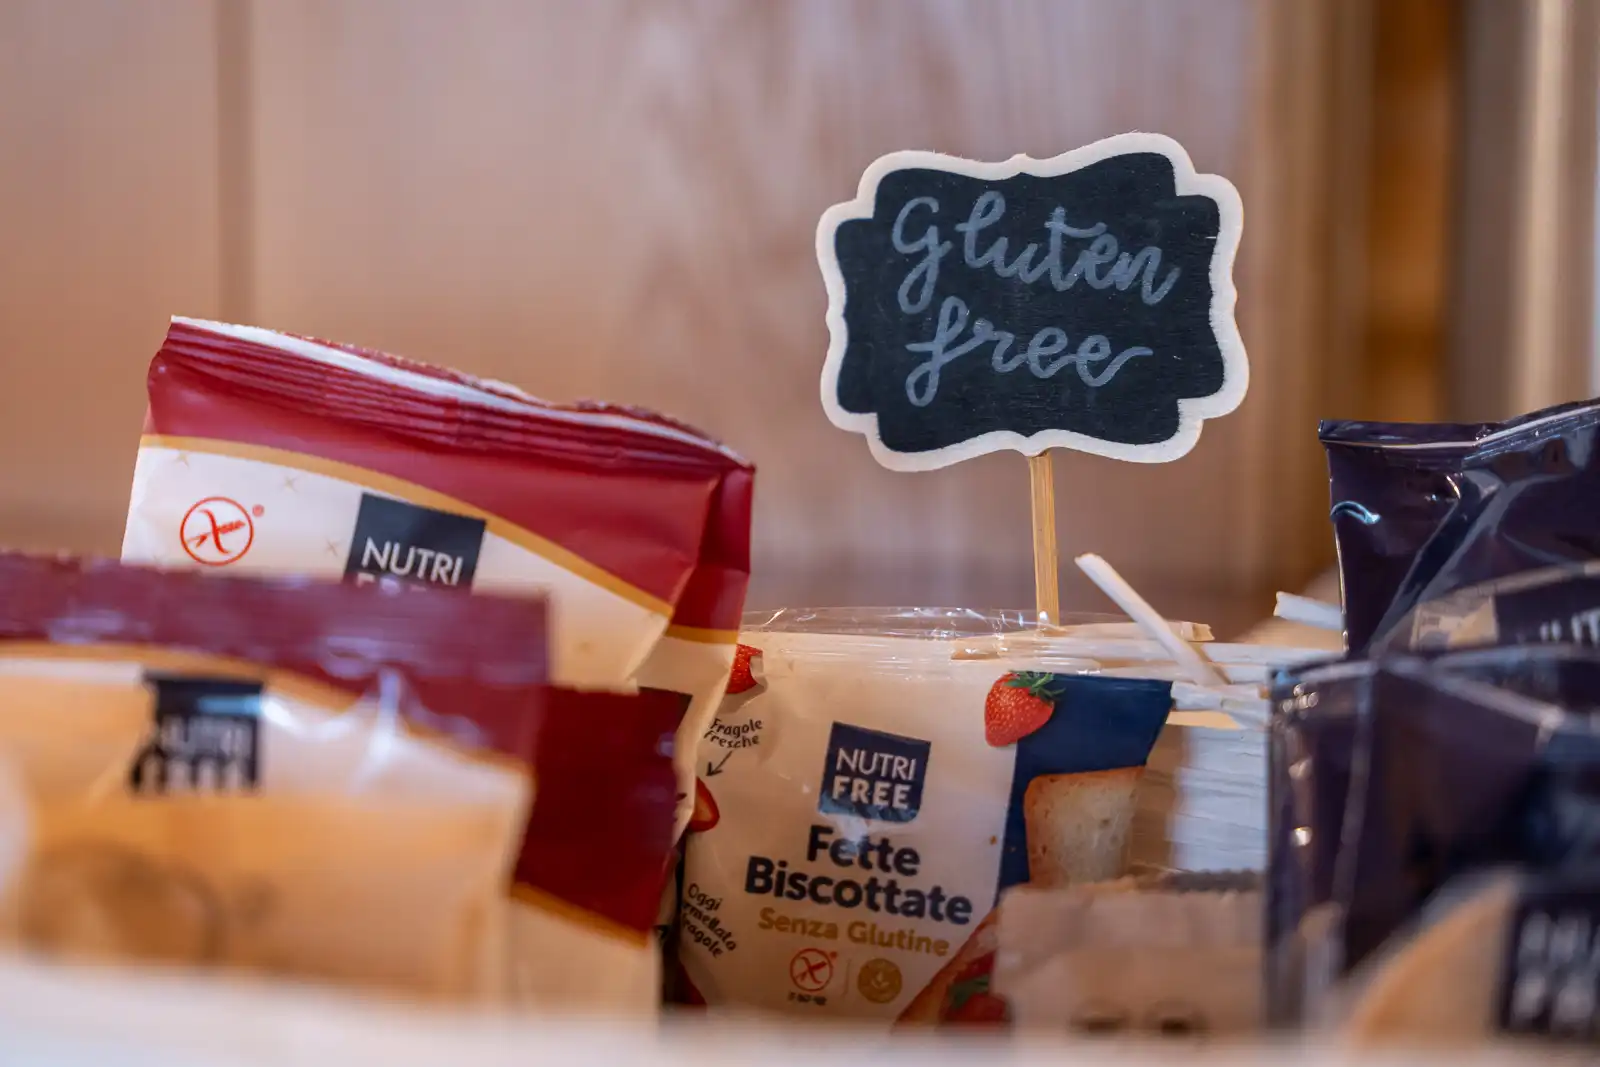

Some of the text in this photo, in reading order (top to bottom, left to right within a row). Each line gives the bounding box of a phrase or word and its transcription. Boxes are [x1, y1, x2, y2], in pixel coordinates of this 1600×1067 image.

[905, 296, 1153, 407] free
[361, 537, 463, 586] NUTRI
[710, 717, 763, 739] Fragole
[836, 747, 917, 781] NUTRI
[832, 776, 912, 809] FREE
[807, 824, 921, 876] Fette
[688, 883, 723, 911] Oggi
[744, 855, 973, 925] Biscottate
[758, 906, 950, 957] Senza Glutine
